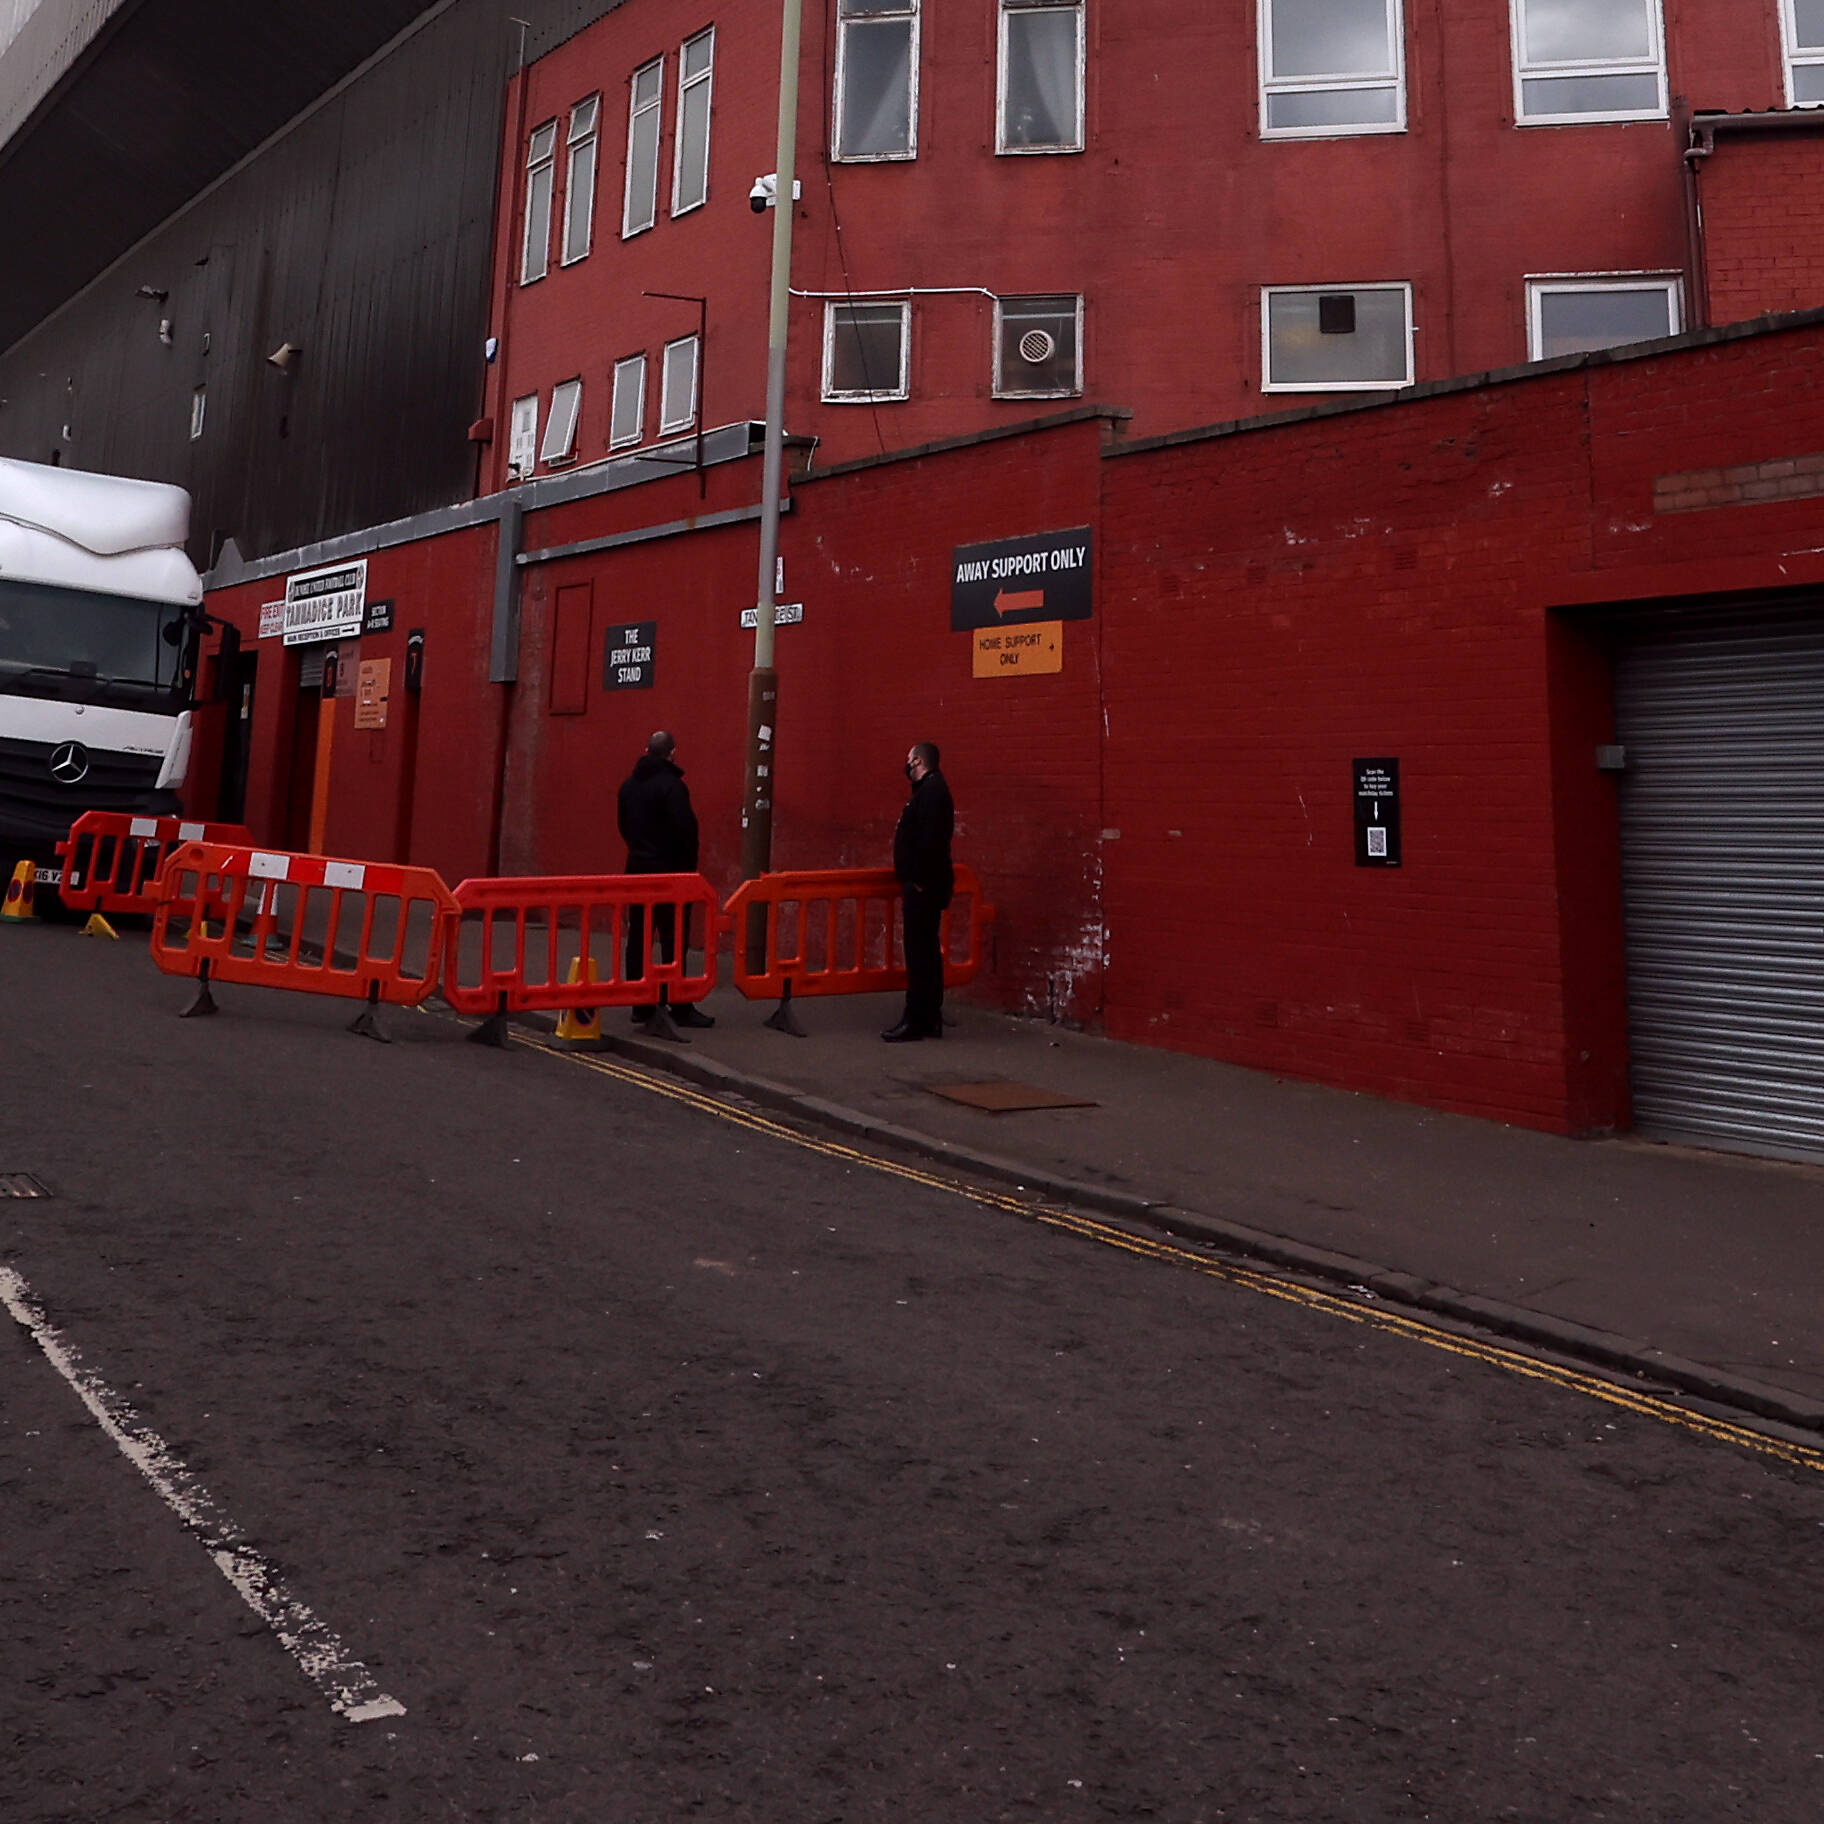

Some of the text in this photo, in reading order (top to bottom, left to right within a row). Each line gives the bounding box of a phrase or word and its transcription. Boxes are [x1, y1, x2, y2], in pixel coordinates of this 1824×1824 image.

[956, 546, 1086, 584] AWAY SUPPORT ONLY
[336, 591, 363, 619] PARK
[624, 628, 639, 645] THE
[979, 633, 1042, 650] HOME SUPPORT
[610, 646, 651, 667] JERRY KERR
[617, 667, 641, 683] STAND
